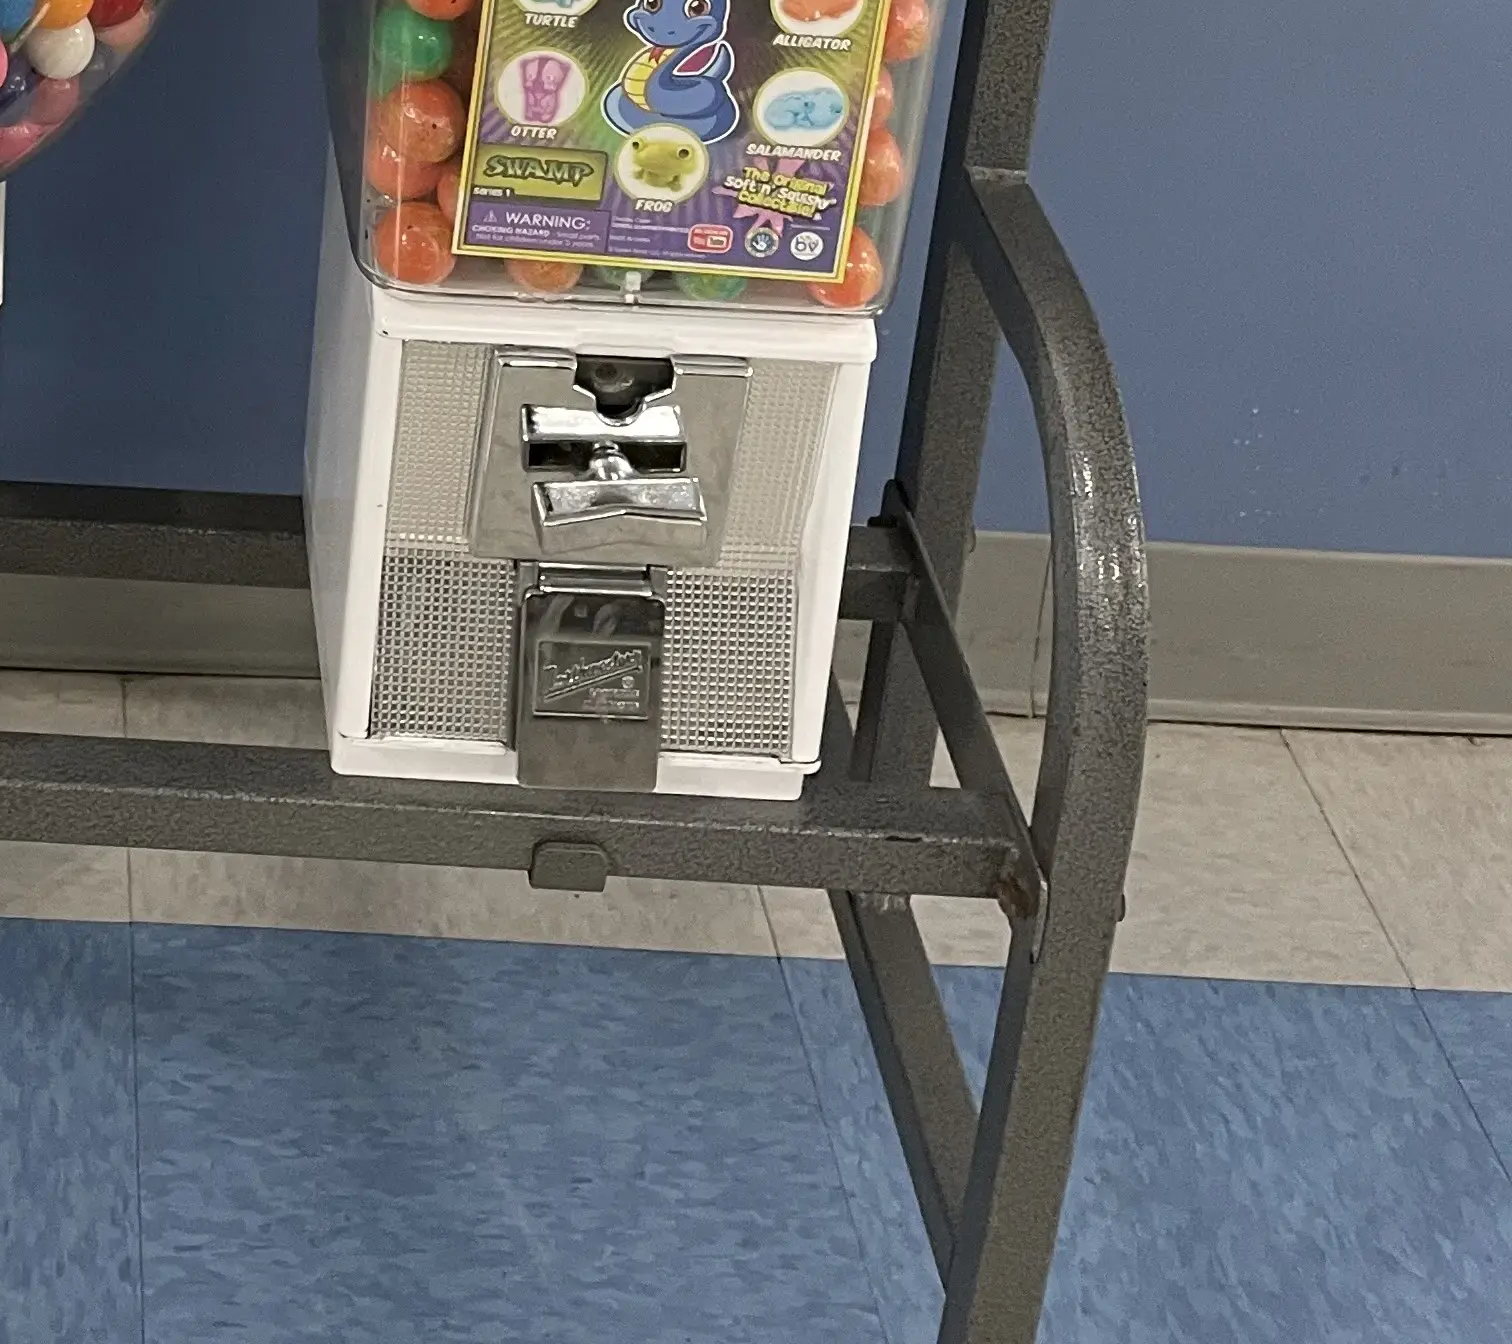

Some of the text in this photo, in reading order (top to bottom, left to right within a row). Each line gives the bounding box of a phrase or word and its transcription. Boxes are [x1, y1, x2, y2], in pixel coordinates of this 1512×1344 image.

[524, 14, 579, 29] TURTLE
[773, 33, 852, 51] ALLIGATOR
[510, 125, 558, 140] OTTER
[746, 144, 843, 162] SALAMANDER
[484, 155, 595, 188] SWAMP
[473, 187, 503, 197] Series
[724, 176, 757, 193] Soft
[635, 198, 673, 214] FROG
[506, 211, 591, 232] WARNING:
[471, 224, 514, 235] CHOKING
[515, 227, 551, 238] HAZARD
